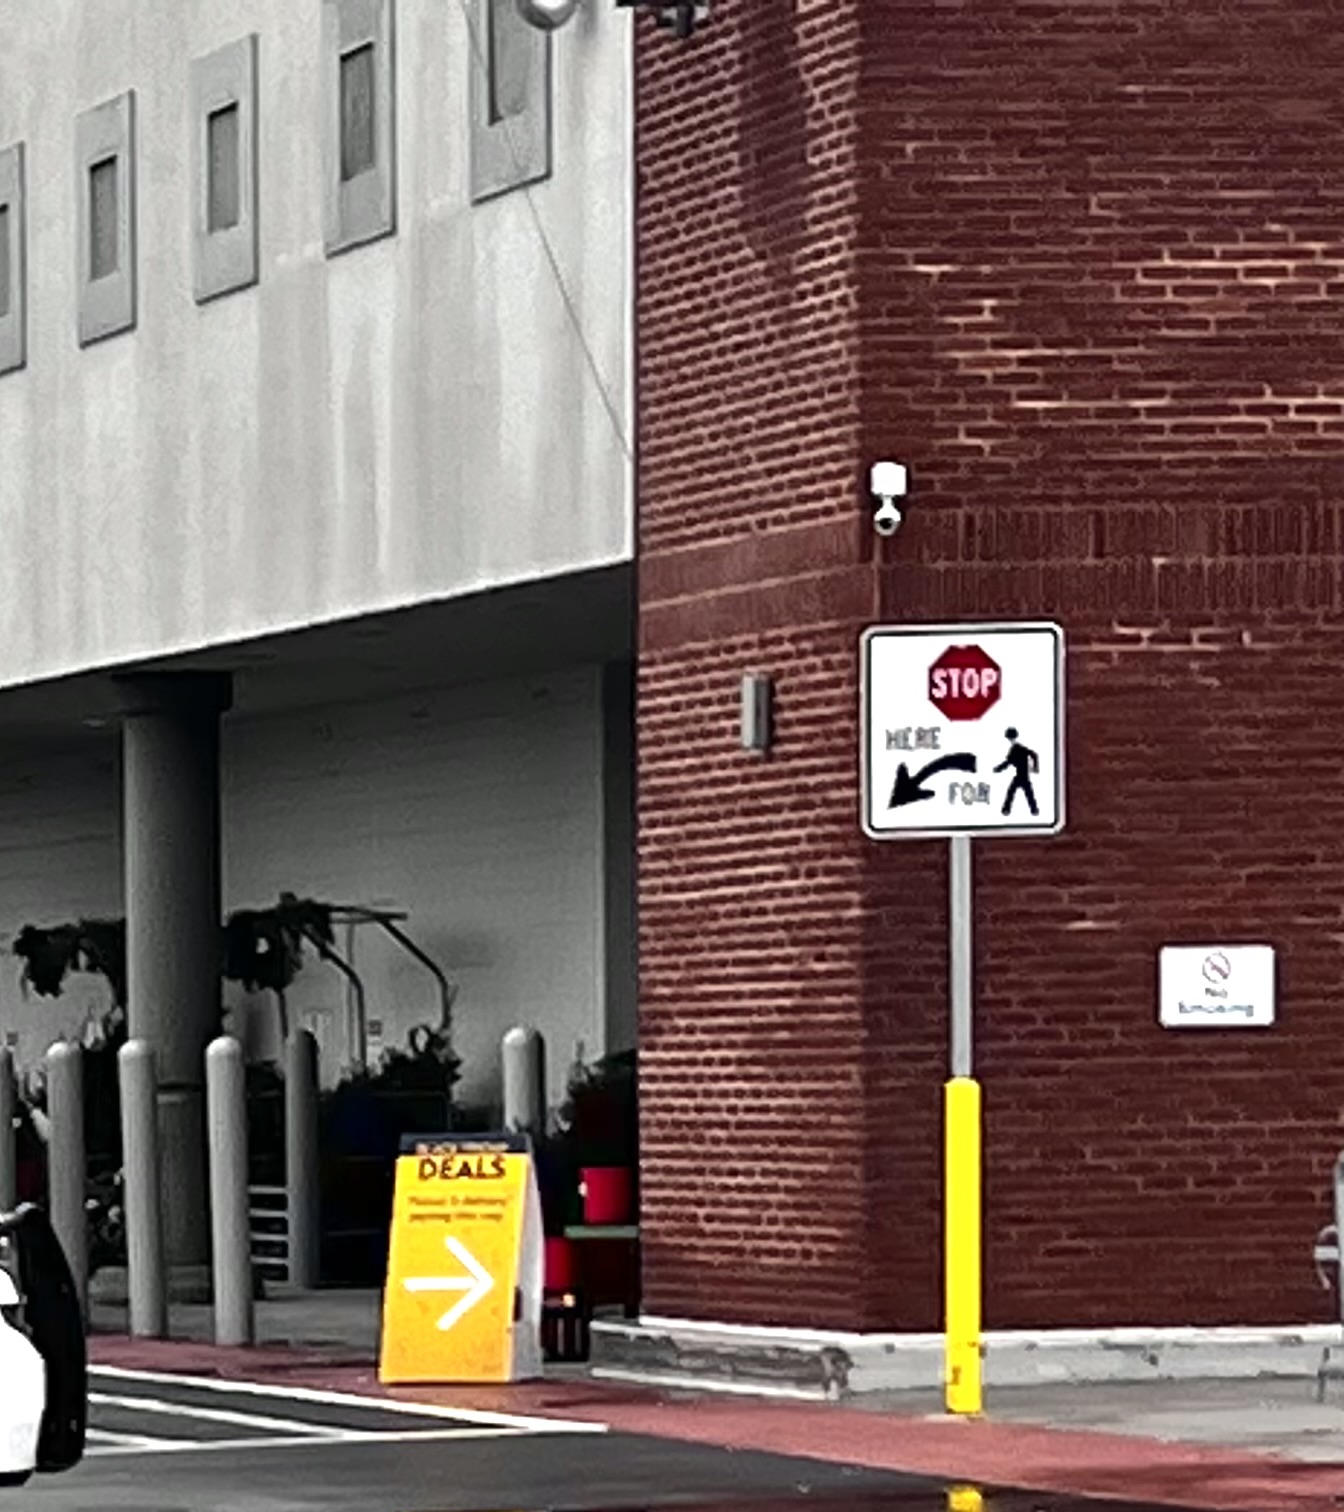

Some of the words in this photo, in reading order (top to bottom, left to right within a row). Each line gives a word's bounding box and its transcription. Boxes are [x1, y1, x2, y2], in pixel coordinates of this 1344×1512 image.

[931, 667, 999, 699] STOP
[885, 726, 942, 751] HERE
[948, 781, 991, 806] FOR
[417, 1153, 507, 1181] DEALS
